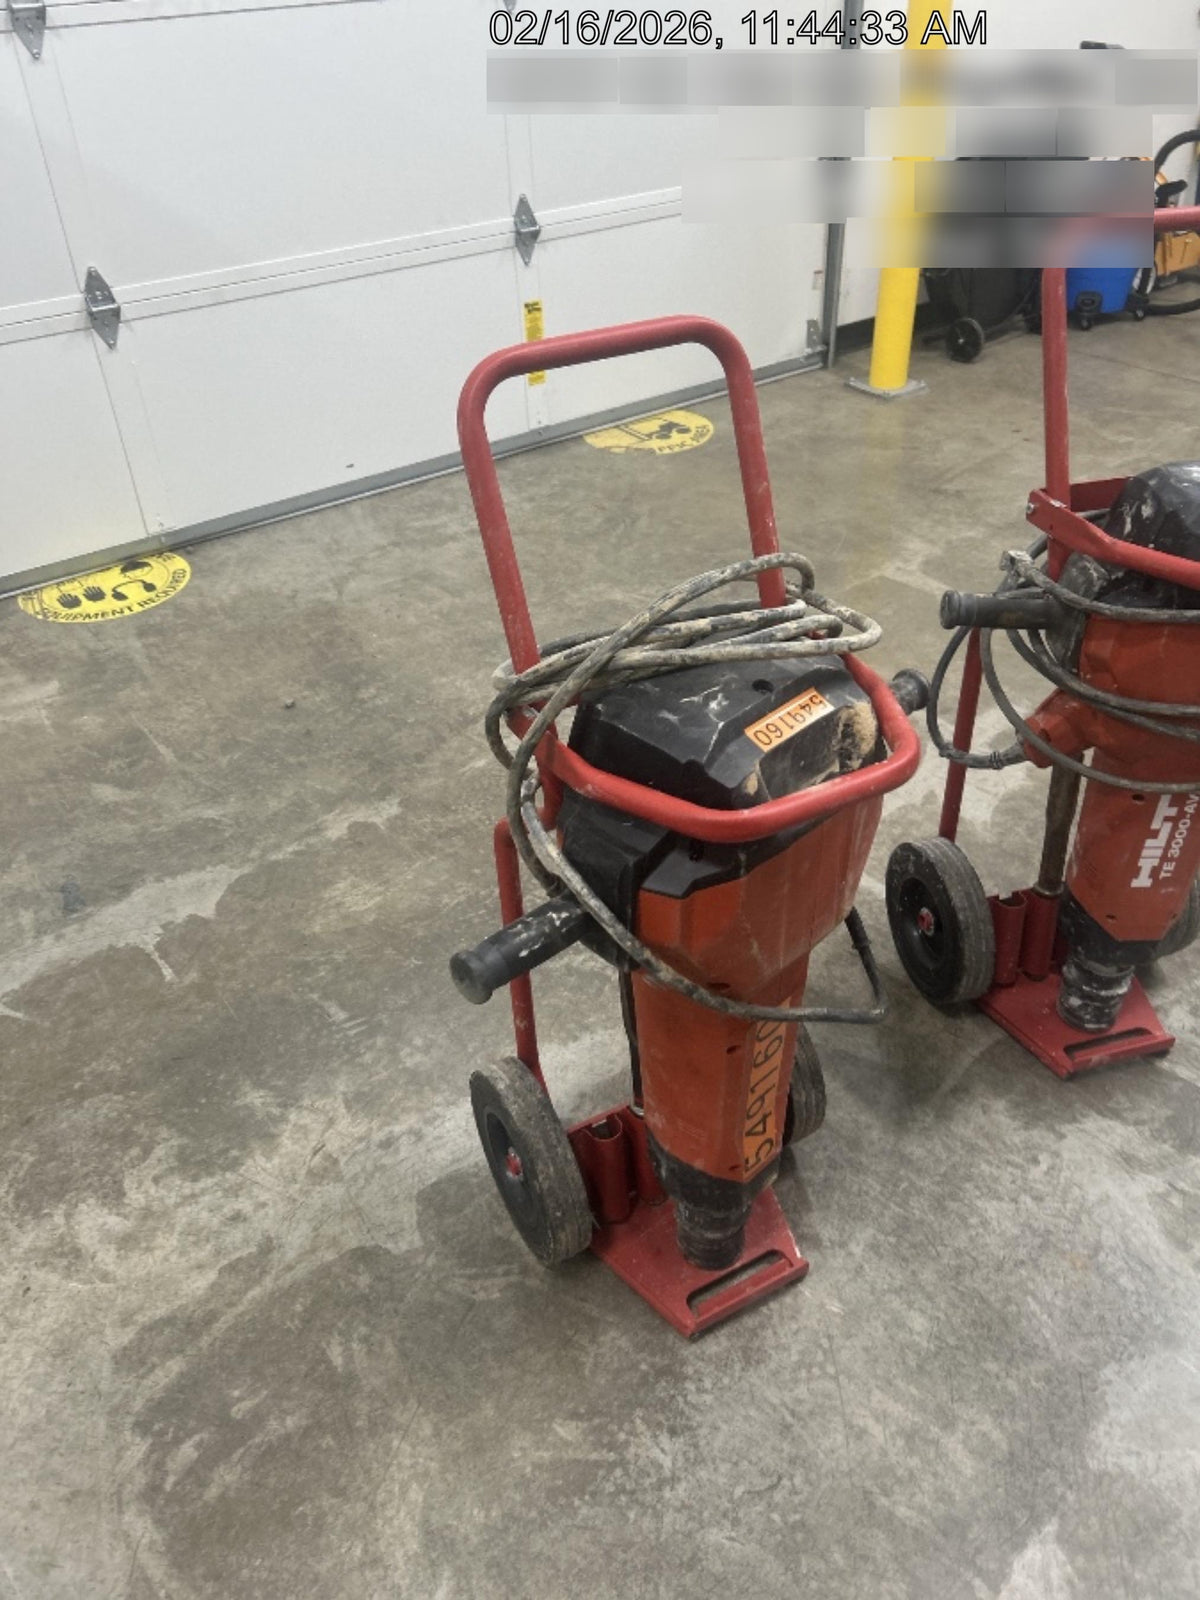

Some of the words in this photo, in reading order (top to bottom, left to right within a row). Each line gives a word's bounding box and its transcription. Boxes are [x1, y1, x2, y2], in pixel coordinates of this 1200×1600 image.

[753, 694, 827, 746] 549160
[1130, 793, 1179, 888] HILT
[1167, 790, 1200, 858] 3000-AV
[1159, 861, 1176, 880] TE
[744, 1020, 783, 1173] 549160
